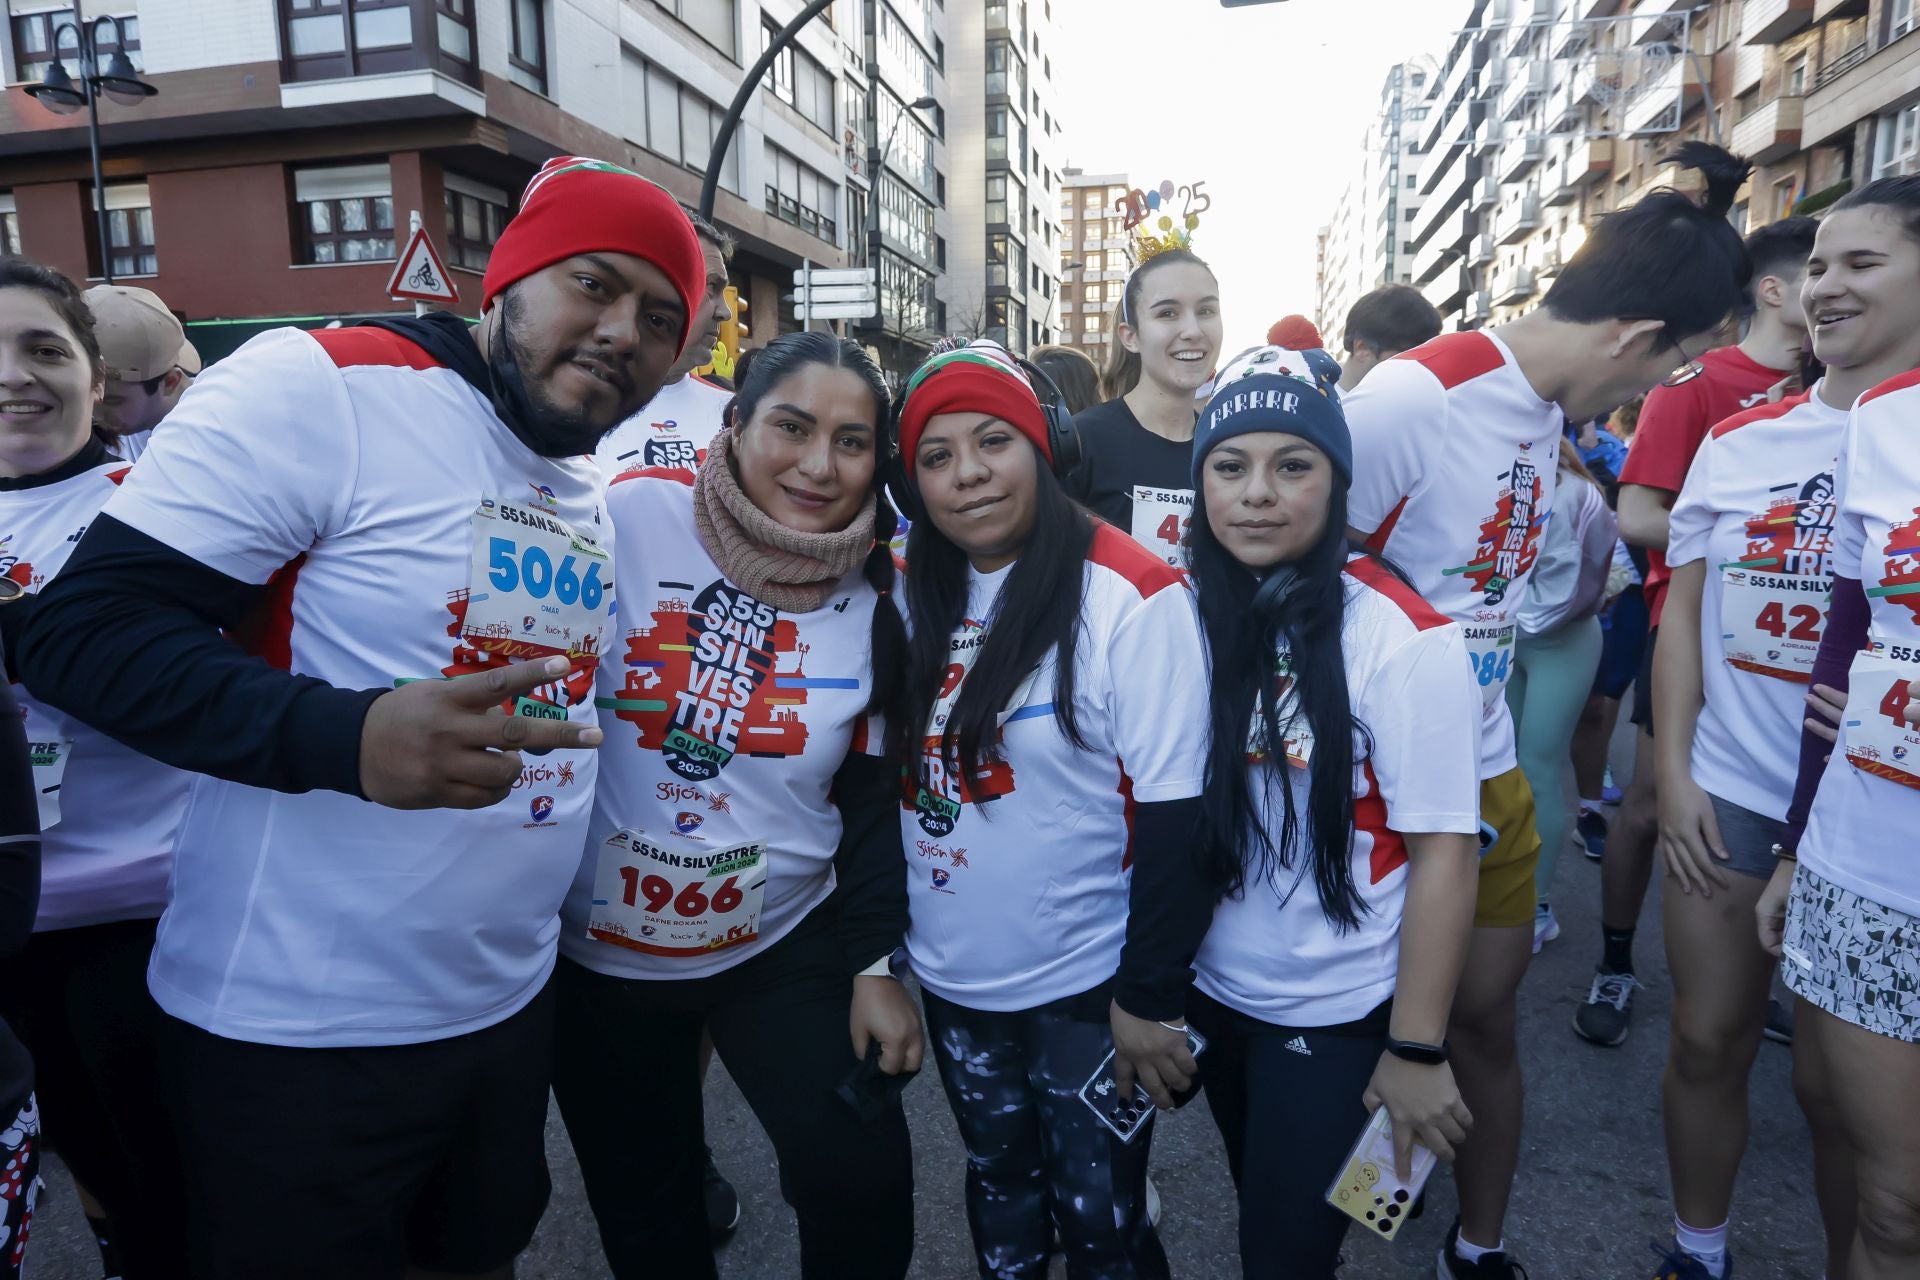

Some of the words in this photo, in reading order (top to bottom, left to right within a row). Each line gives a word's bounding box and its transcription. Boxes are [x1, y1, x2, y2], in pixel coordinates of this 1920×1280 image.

[1178, 180, 1211, 219] 25
[665, 442, 695, 460] 55
[1522, 466, 1535, 487] 55
[1156, 493, 1170, 502] 55
[1171, 495, 1193, 506] SAN
[1514, 478, 1533, 505] SAN
[500, 505, 519, 523] 55
[519, 510, 547, 532] SAN
[1511, 502, 1529, 527] SIL
[1503, 527, 1527, 551] VES
[488, 536, 603, 611] 5066
[1496, 550, 1520, 579] TRE
[1750, 576, 1766, 588] 55
[1768, 579, 1797, 591] SAN
[541, 604, 560, 615] OMAR
[730, 593, 774, 629] 55
[703, 602, 766, 652] SAN
[1464, 628, 1486, 639] SAN
[695, 631, 755, 677] SIL
[951, 637, 974, 651] SAN
[1890, 646, 1911, 662] 55
[688, 661, 753, 709] VES
[675, 690, 746, 755] TRE
[672, 735, 724, 765] GIJÓN
[677, 761, 711, 777] 2024
[656, 782, 706, 804] gijón
[632, 840, 649, 855] 55
[650, 847, 680, 868] SAN
[683, 845, 760, 868] SILVESTRE
[711, 862, 736, 876] GIJÓN
[737, 856, 757, 870] 2024
[619, 865, 744, 918] 1966
[1284, 1043, 1312, 1056] adidas
